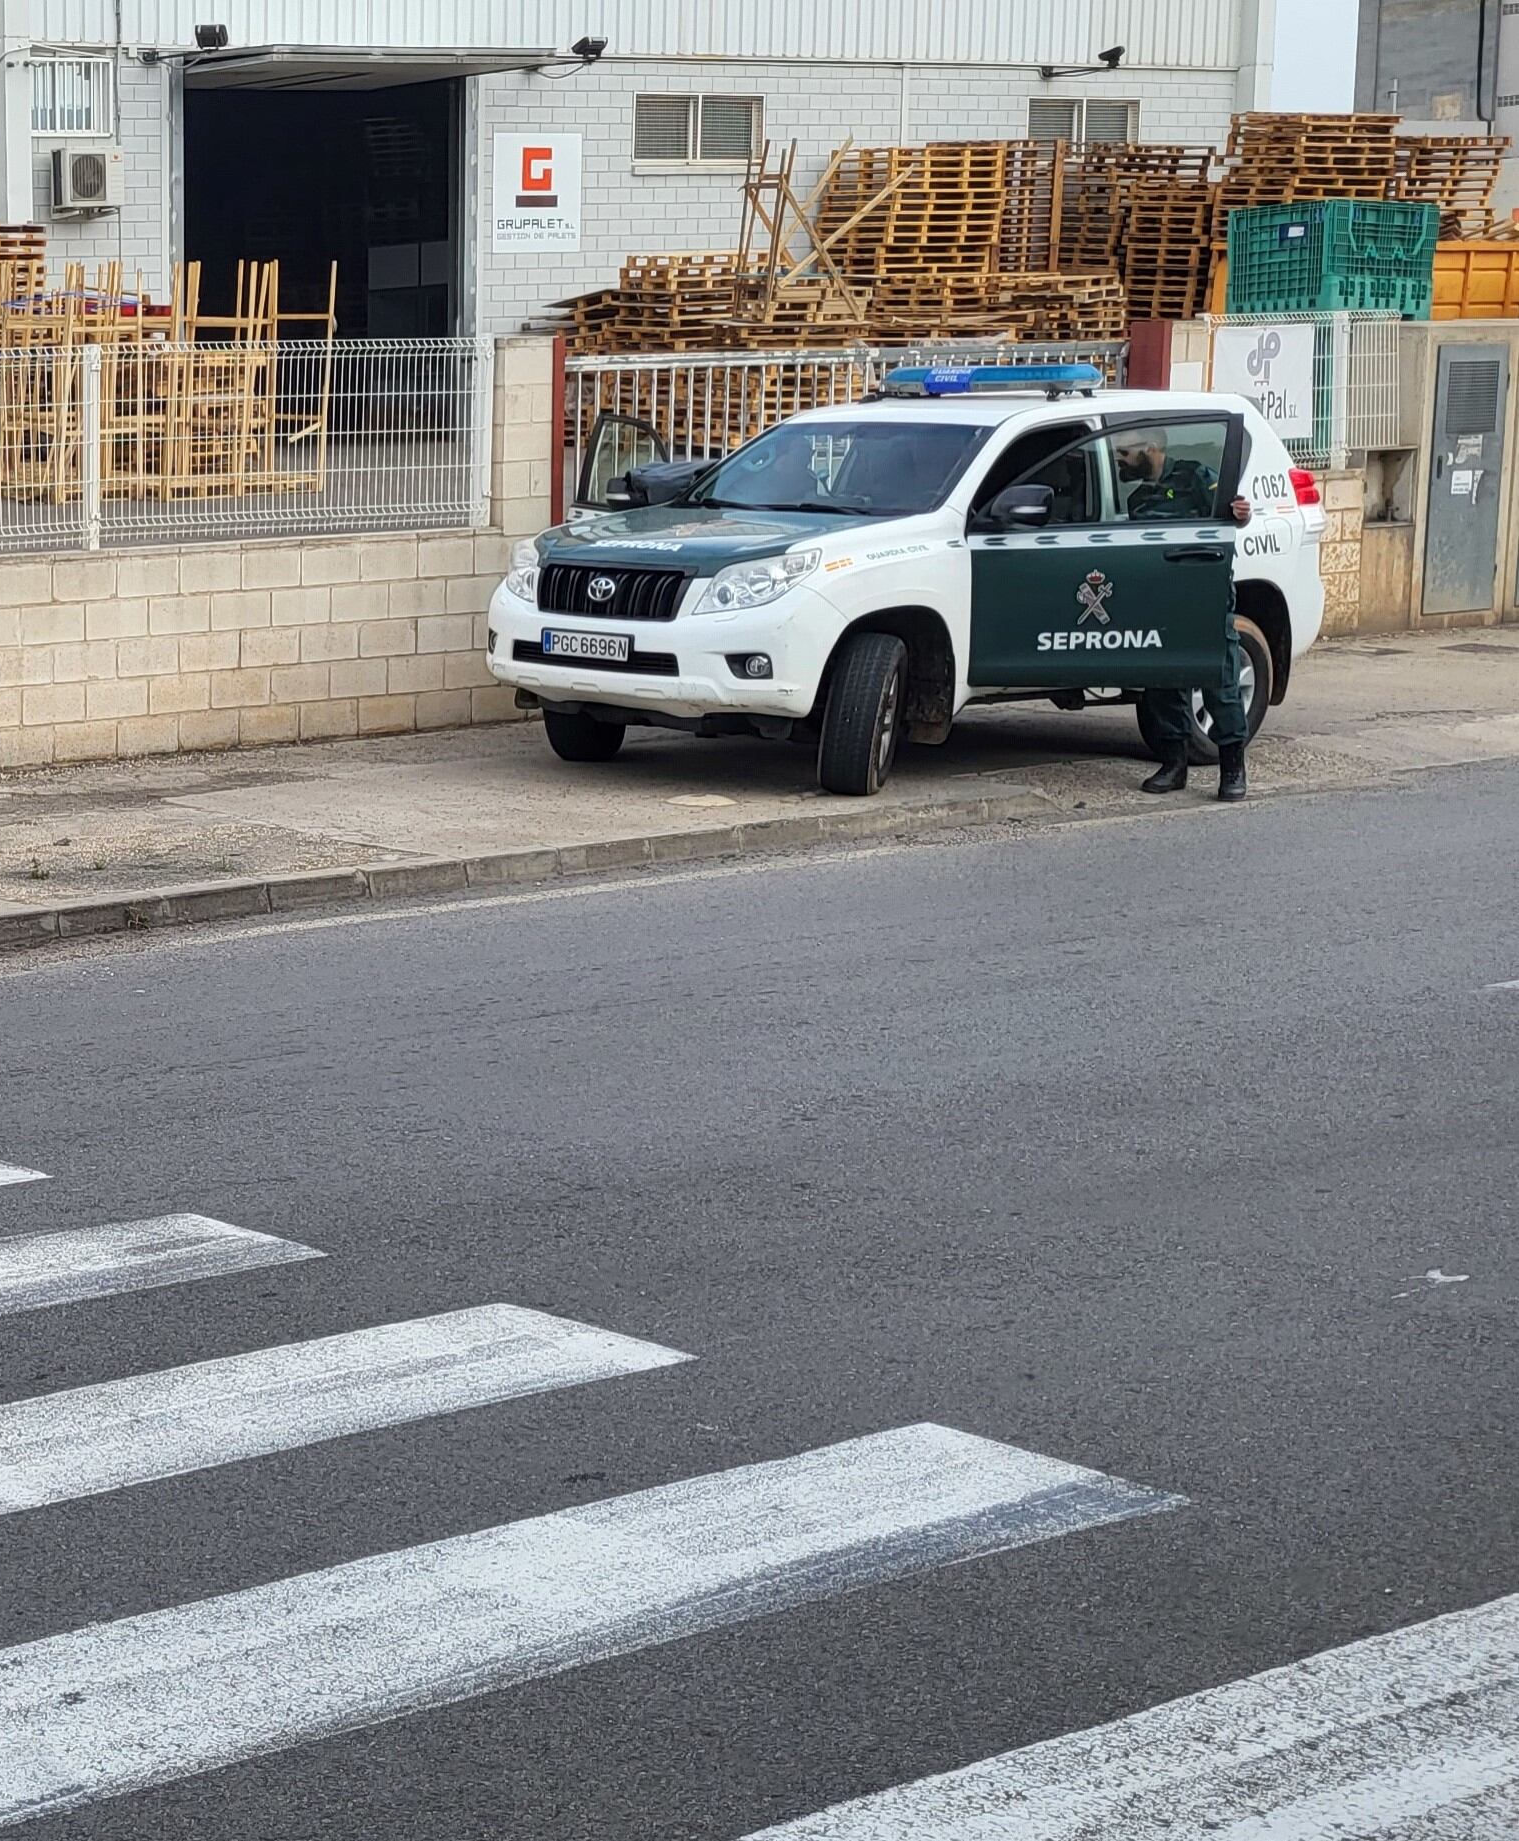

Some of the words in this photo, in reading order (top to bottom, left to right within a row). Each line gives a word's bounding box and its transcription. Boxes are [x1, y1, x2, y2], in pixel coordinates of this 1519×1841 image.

[497, 218, 564, 230] GRUPALET
[1261, 473, 1288, 499] 062
[1243, 533, 1281, 556] CIVIL
[1037, 629, 1163, 651] SEPRONA
